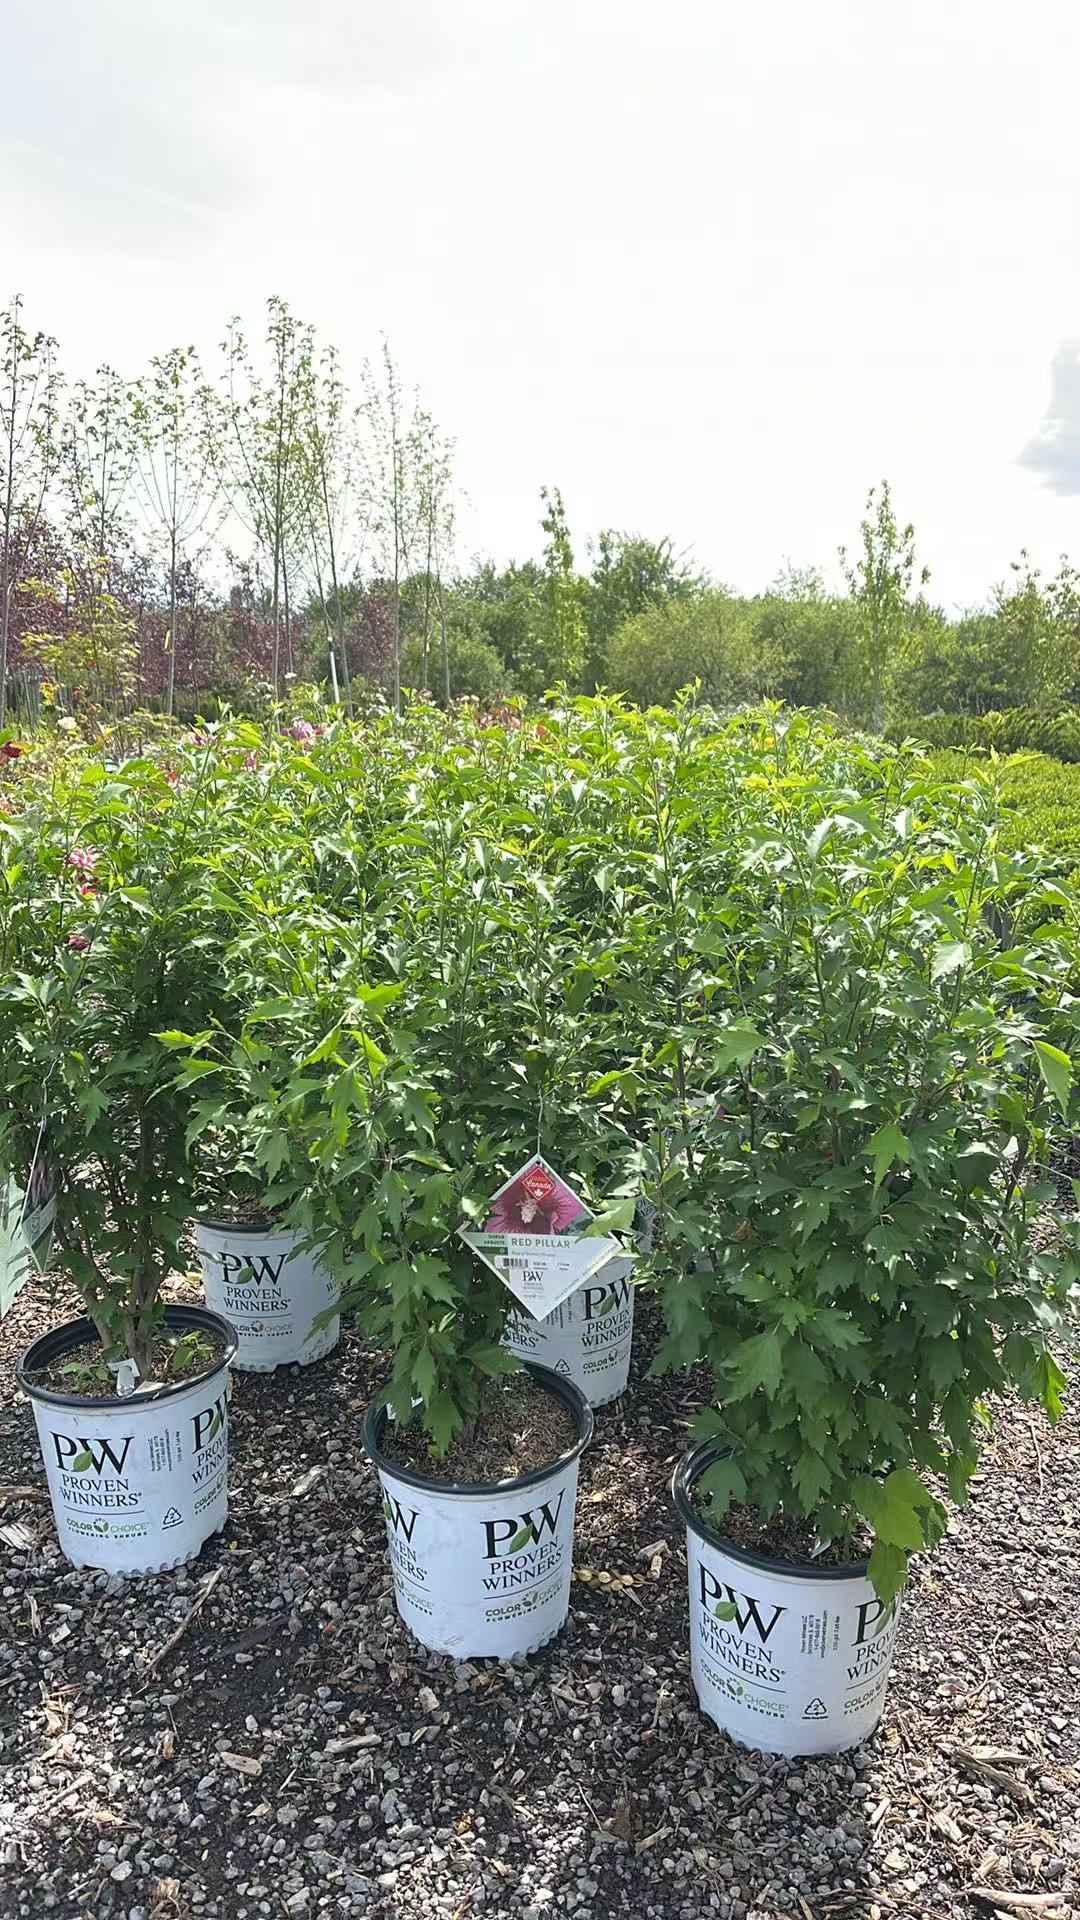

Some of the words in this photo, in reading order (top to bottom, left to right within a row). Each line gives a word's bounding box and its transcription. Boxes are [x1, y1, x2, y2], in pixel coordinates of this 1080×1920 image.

[511, 1237, 532, 1247] RED
[535, 1239, 570, 1249] PILLAR
[218, 1251, 288, 1287] PW
[226, 1286, 282, 1300] PROVEN
[587, 1309, 630, 1336] PROVEN
[583, 1358, 608, 1370] COLOR
[49, 1431, 135, 1476] PW
[62, 1474, 129, 1493] PROVEN
[66, 1518, 93, 1531] COLOR
[110, 1522, 147, 1533] CHOICE
[480, 1488, 566, 1560] PW
[490, 1536, 559, 1575] PROVEN
[485, 1603, 521, 1617] COLOR
[697, 1560, 788, 1644] PW
[702, 1612, 774, 1664] PROVEN
[700, 1659, 725, 1688] COLOR
[744, 1693, 786, 1712] CHOICE
